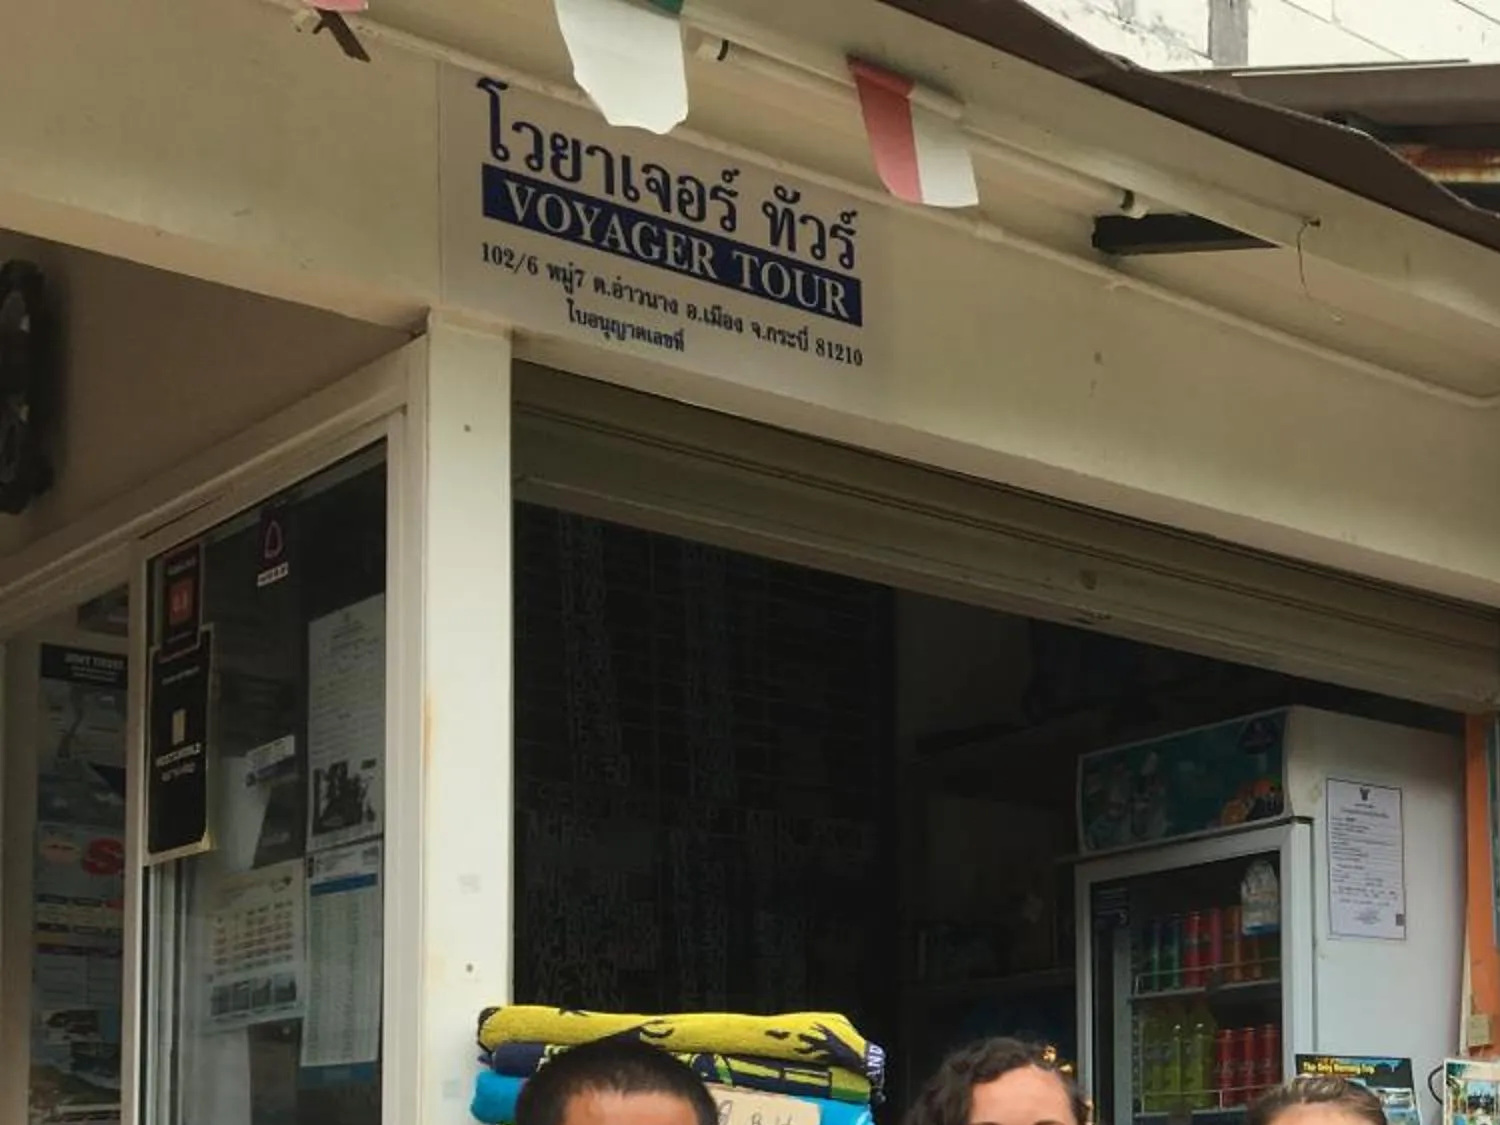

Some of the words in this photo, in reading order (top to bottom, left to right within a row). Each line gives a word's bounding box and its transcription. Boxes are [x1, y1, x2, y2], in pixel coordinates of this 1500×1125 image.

[477, 77, 740, 234] โวยาเจอร์
[761, 185, 859, 270] ทัวร์
[482, 242, 539, 276] 102/6
[816, 337, 864, 366] 81210
[502, 179, 720, 281] VOYAGER
[732, 248, 850, 320] TOUR
